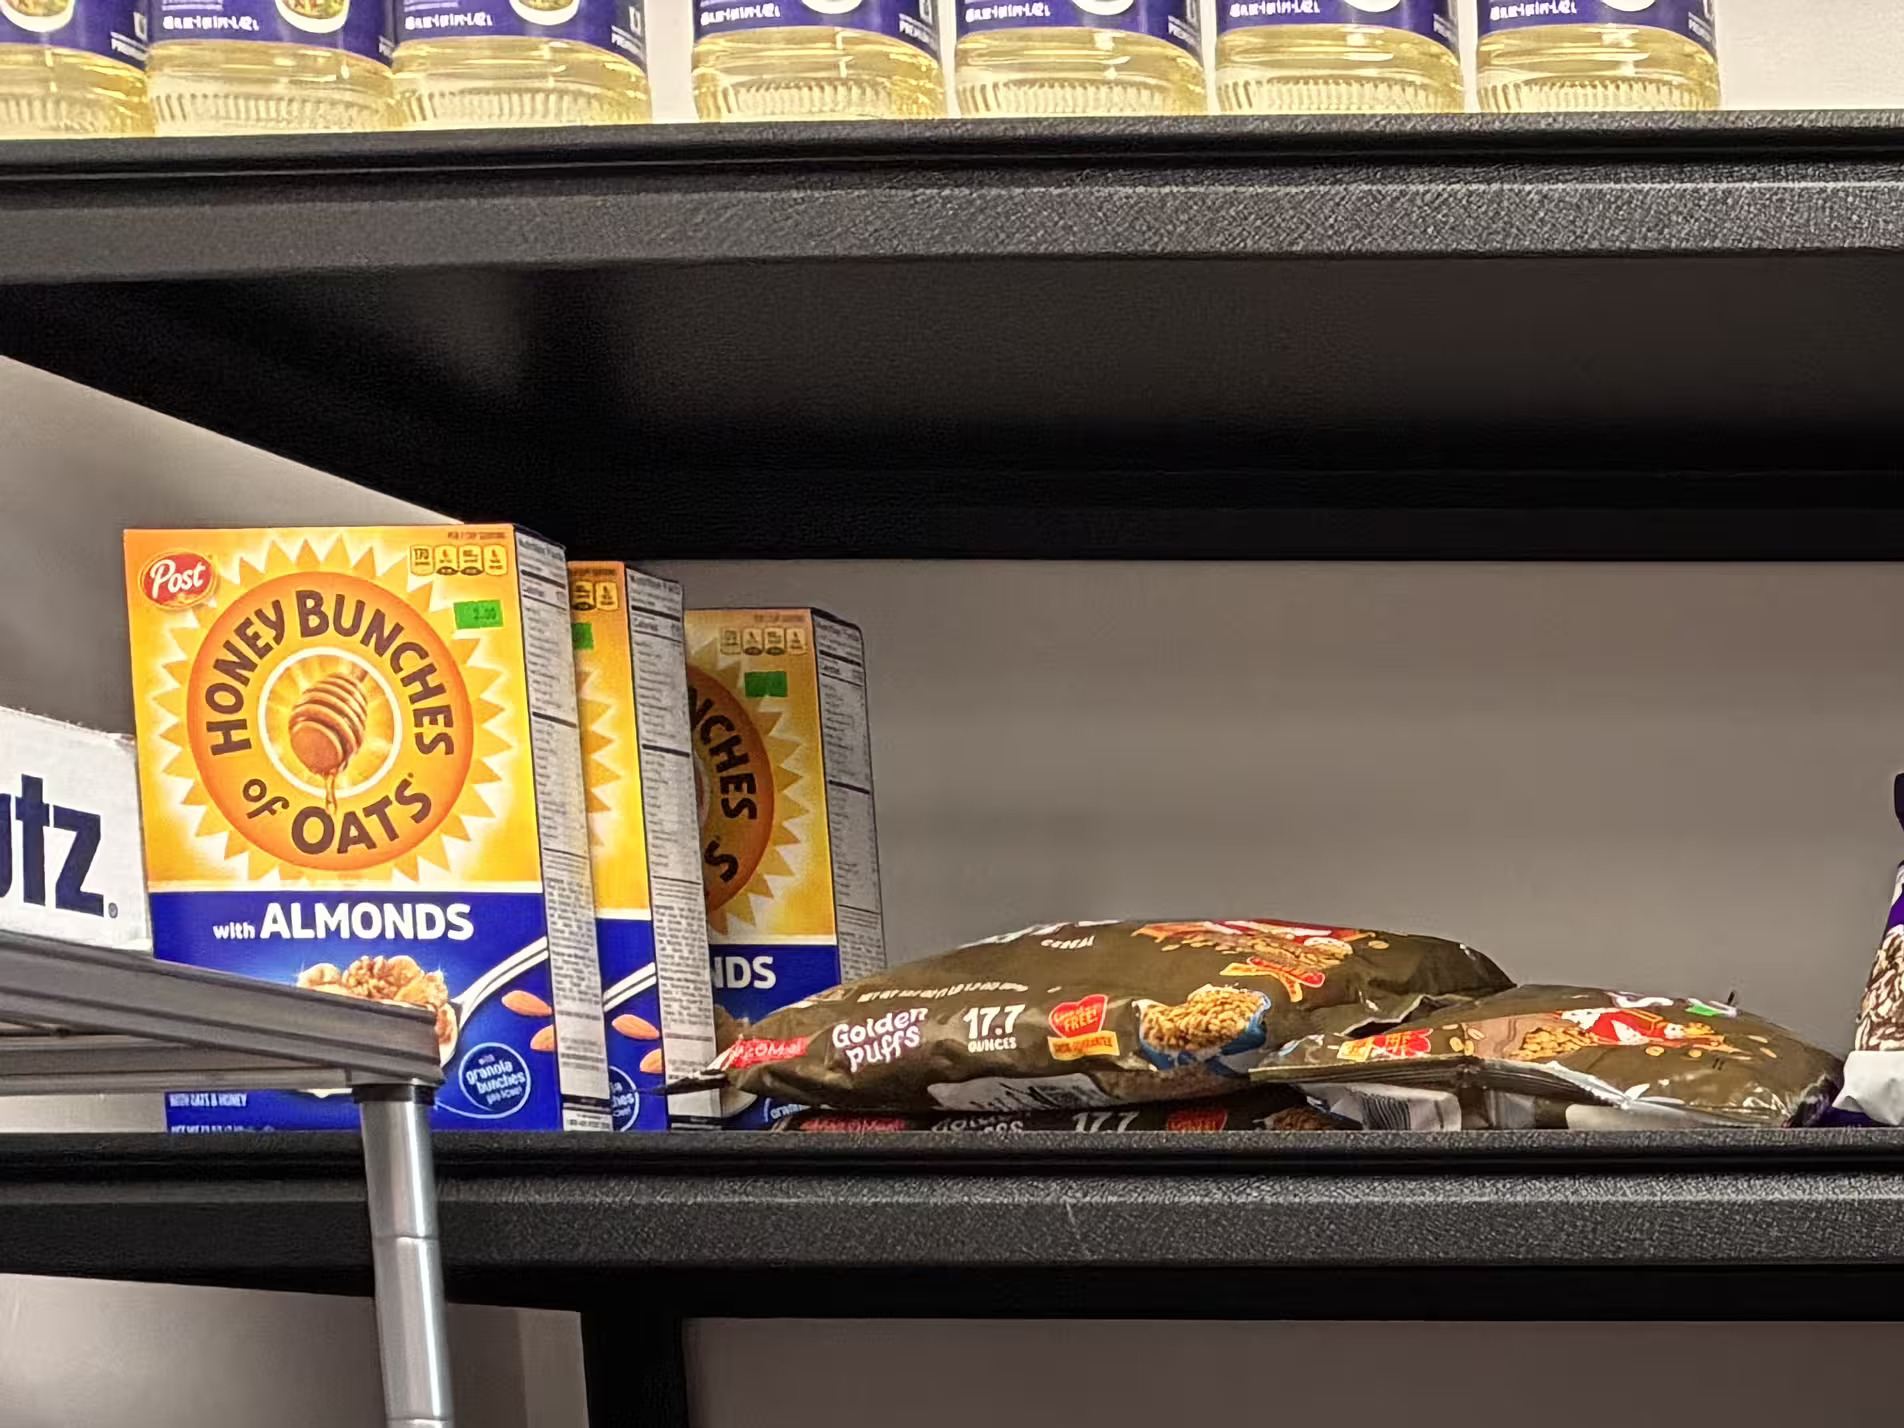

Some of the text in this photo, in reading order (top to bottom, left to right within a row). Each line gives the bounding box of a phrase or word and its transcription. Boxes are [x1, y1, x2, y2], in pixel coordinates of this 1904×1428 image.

[149, 556, 205, 593] Post
[210, 594, 285, 757] HONEY
[301, 588, 454, 757] BUNCHES
[290, 775, 433, 857] OATS
[213, 903, 474, 941] with ALMONDS
[832, 1008, 928, 1049] Golden
[963, 1004, 1025, 1040] 17.7
[844, 1026, 920, 1073] puffs
